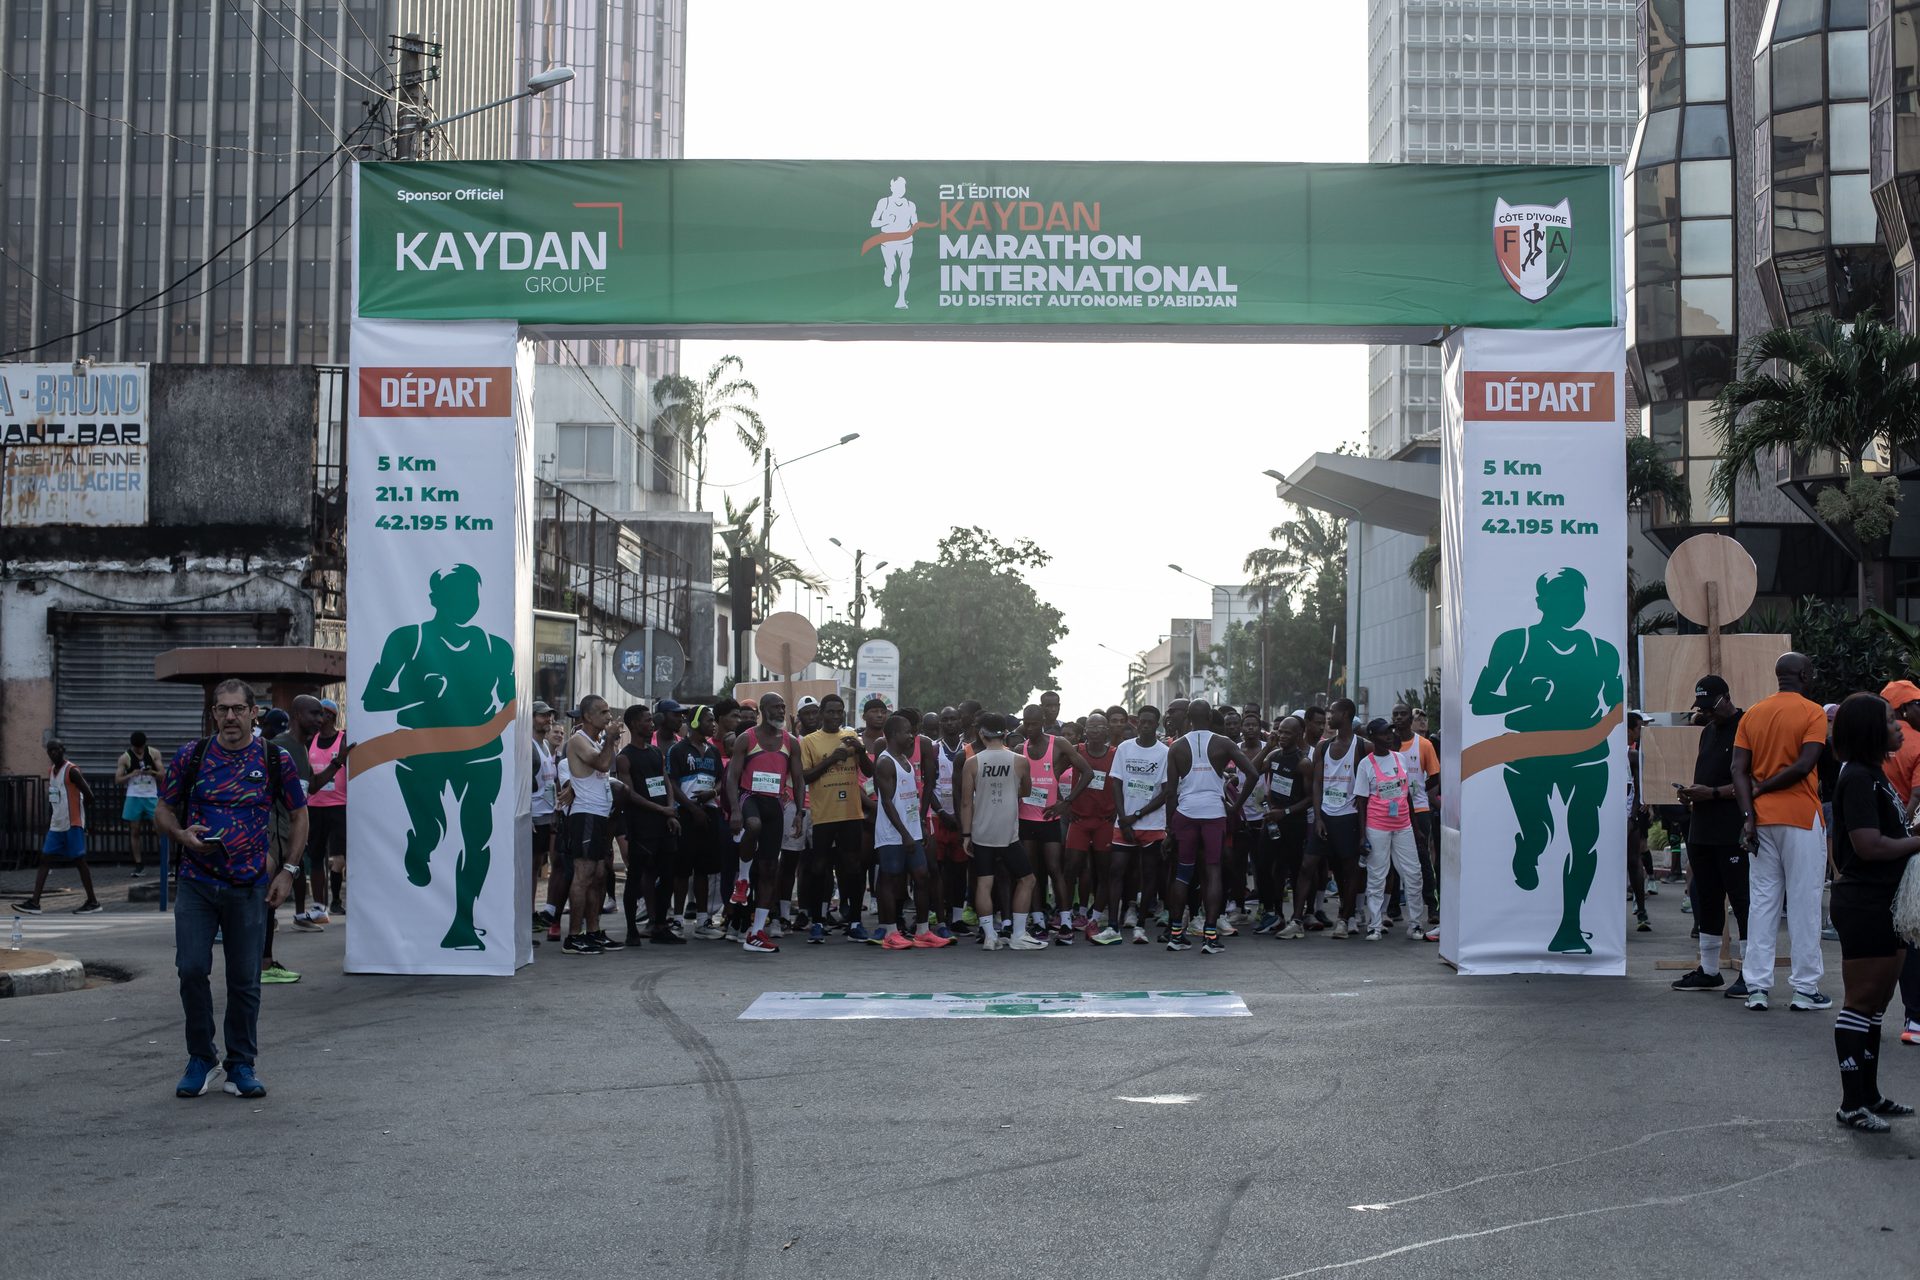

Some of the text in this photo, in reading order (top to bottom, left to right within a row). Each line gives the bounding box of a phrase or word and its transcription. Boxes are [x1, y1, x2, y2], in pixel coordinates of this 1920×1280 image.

[397, 188, 504, 203] Sponsor Officiel
[969, 182, 1030, 199] ÉDITION
[940, 201, 1101, 231] KAYDAN
[1499, 212, 1567, 225] CÔTE D'IVOIRE
[939, 234, 1141, 260] MARATHON
[1503, 230, 1568, 253] F A
[396, 231, 607, 272] KAYDAN
[525, 276, 606, 293] GROUPE
[940, 265, 1238, 293] INTERNATIONAL
[939, 294, 1237, 308] DU DISTRICT AUTONOME D'ABIDJAN
[36, 374, 141, 416] BRUNO
[380, 372, 493, 408] DÉPART
[1485, 376, 1596, 412] DÉPART
[377, 456, 436, 471] 5 Km
[1483, 460, 1542, 475] 5 Km
[375, 486, 459, 502] 21.1 Km
[1481, 490, 1565, 506] 21.1 Km
[374, 515, 494, 531] 42.195 Km
[1481, 519, 1599, 534] 42.195 Km
